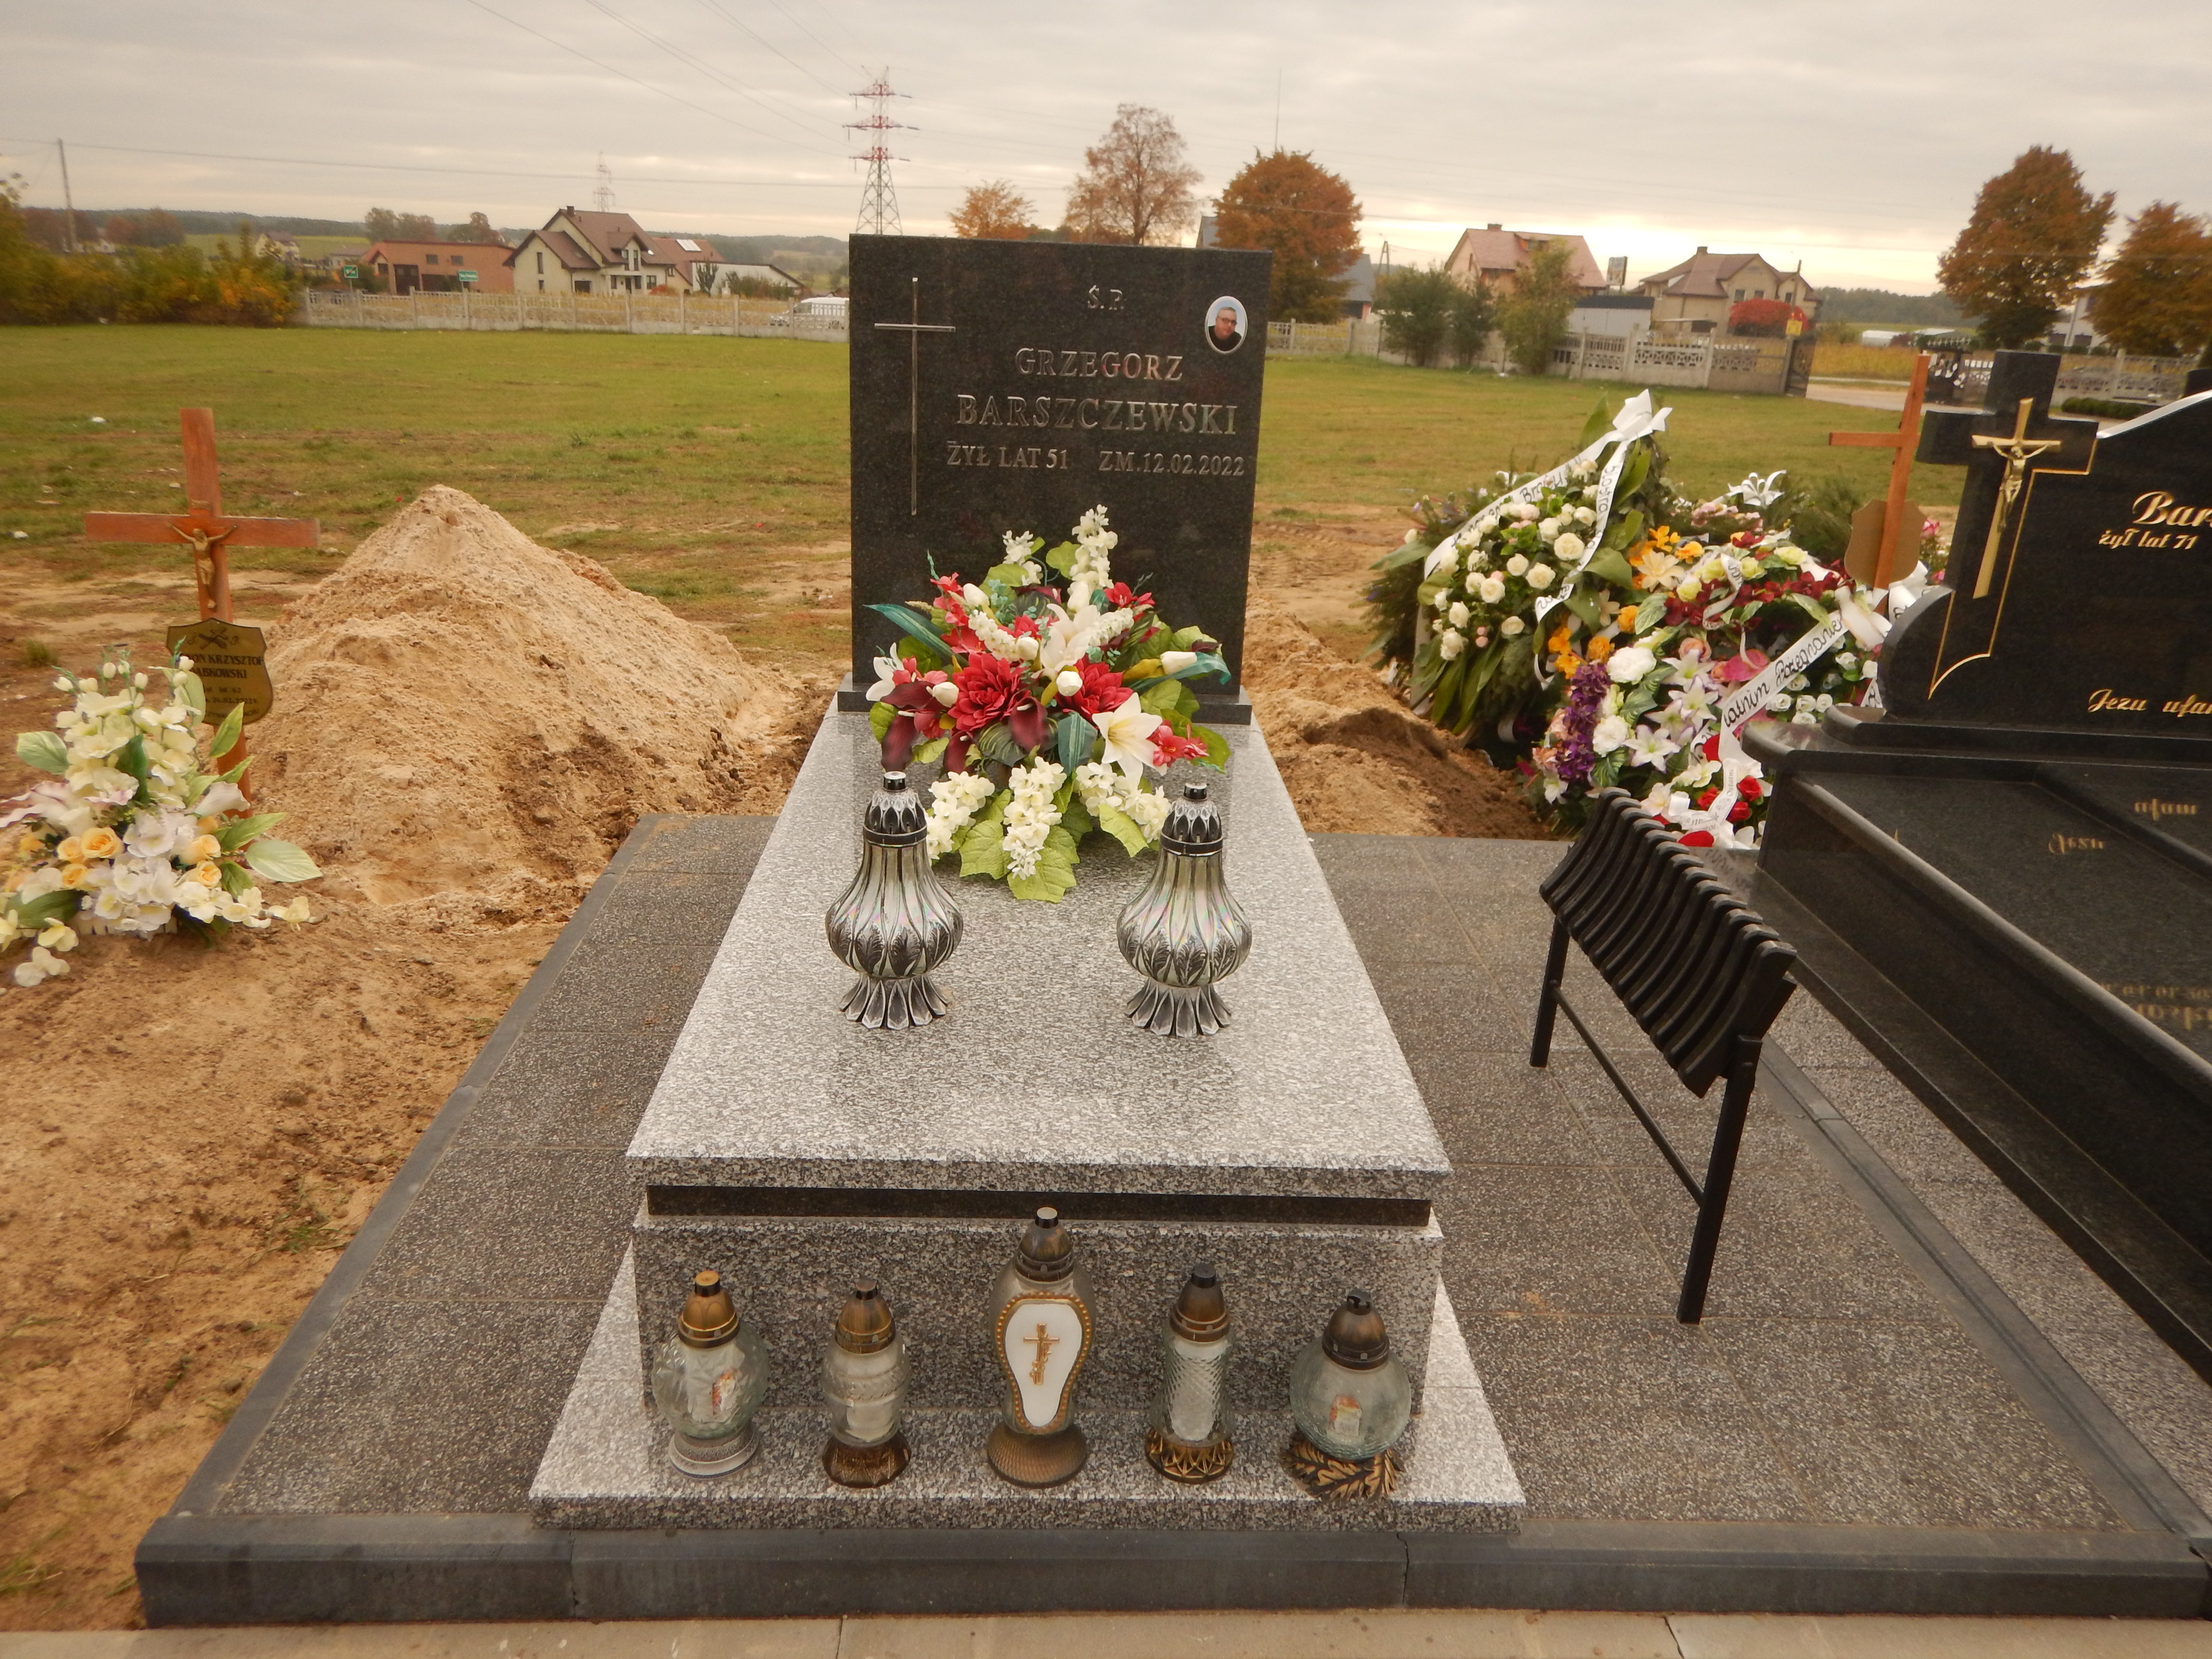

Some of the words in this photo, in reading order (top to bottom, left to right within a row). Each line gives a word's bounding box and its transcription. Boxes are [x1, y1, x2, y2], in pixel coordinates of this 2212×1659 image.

[1015, 348, 1183, 381] GRZEGORZ
[957, 394, 1238, 435] BARSZCZEWSKI
[947, 441, 991, 466] ŻYŁ
[998, 447, 1041, 468] LAT
[1046, 449, 1068, 469] 51
[2132, 490, 2212, 527] Bar
[2098, 529, 2140, 549] żył
[2138, 530, 2172, 548] lat
[2173, 534, 2199, 550] 71
[190, 667, 247, 678] ĄBKOWSKI
[208, 654, 264, 665] KRZYSZTOF
[2088, 688, 2147, 713] Jezu
